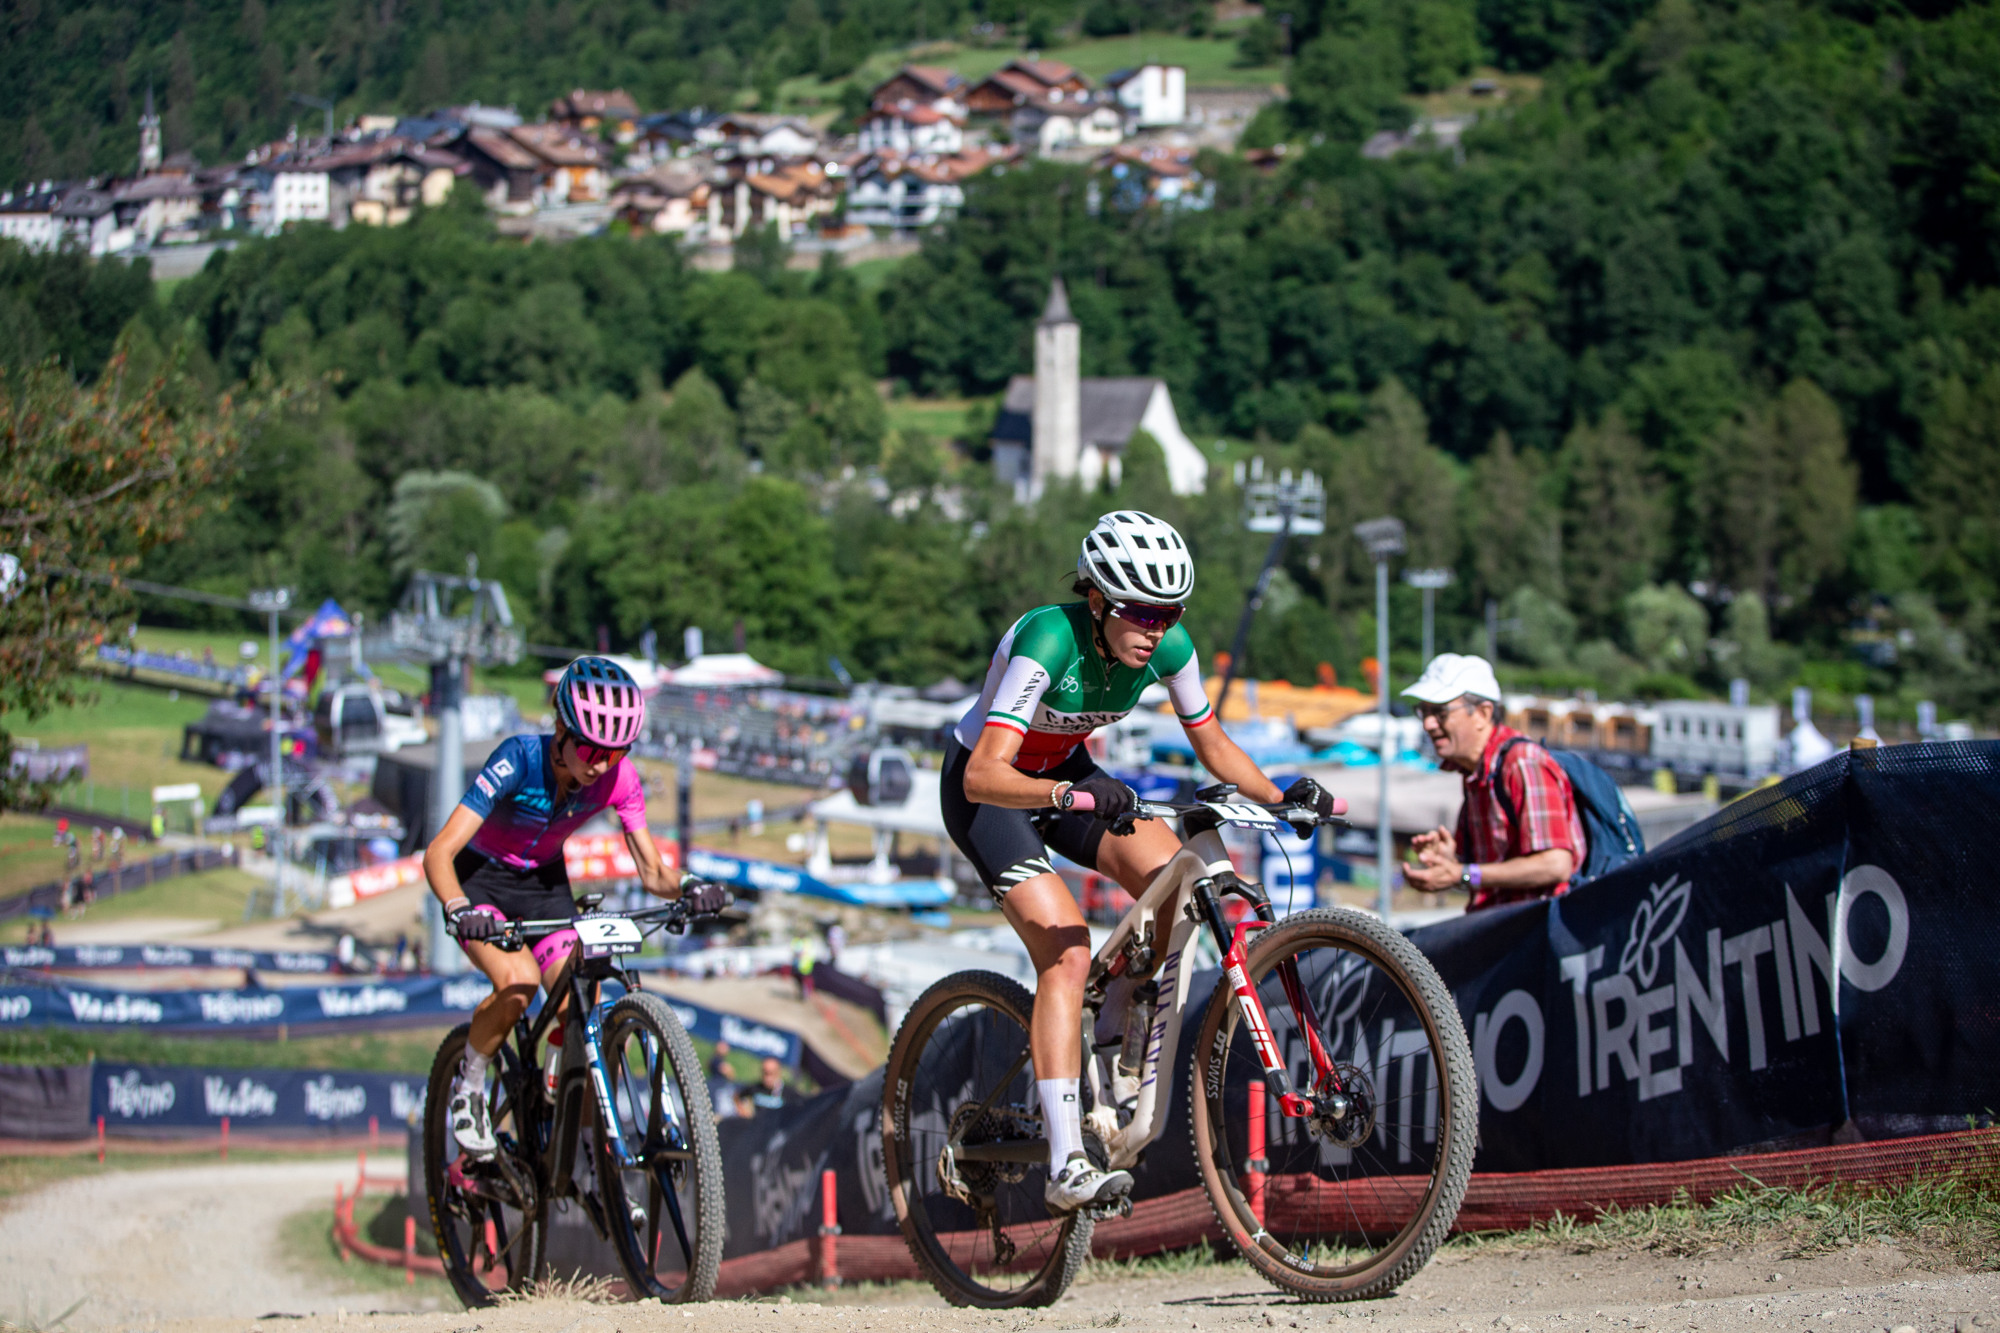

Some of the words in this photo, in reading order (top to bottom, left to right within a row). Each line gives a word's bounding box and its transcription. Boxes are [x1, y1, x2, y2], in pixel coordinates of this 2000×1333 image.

[1010, 671, 1045, 713] CANYON
[1045, 710, 1130, 724] CANYO
[1220, 804, 1258, 816] 11
[599, 923, 620, 937] 2
[1559, 864, 1910, 1101] TRENTINO
[1213, 1029, 1228, 1055] DT
[1207, 1056, 1222, 1099] SWISS
[894, 1102, 906, 1141] SWISS
